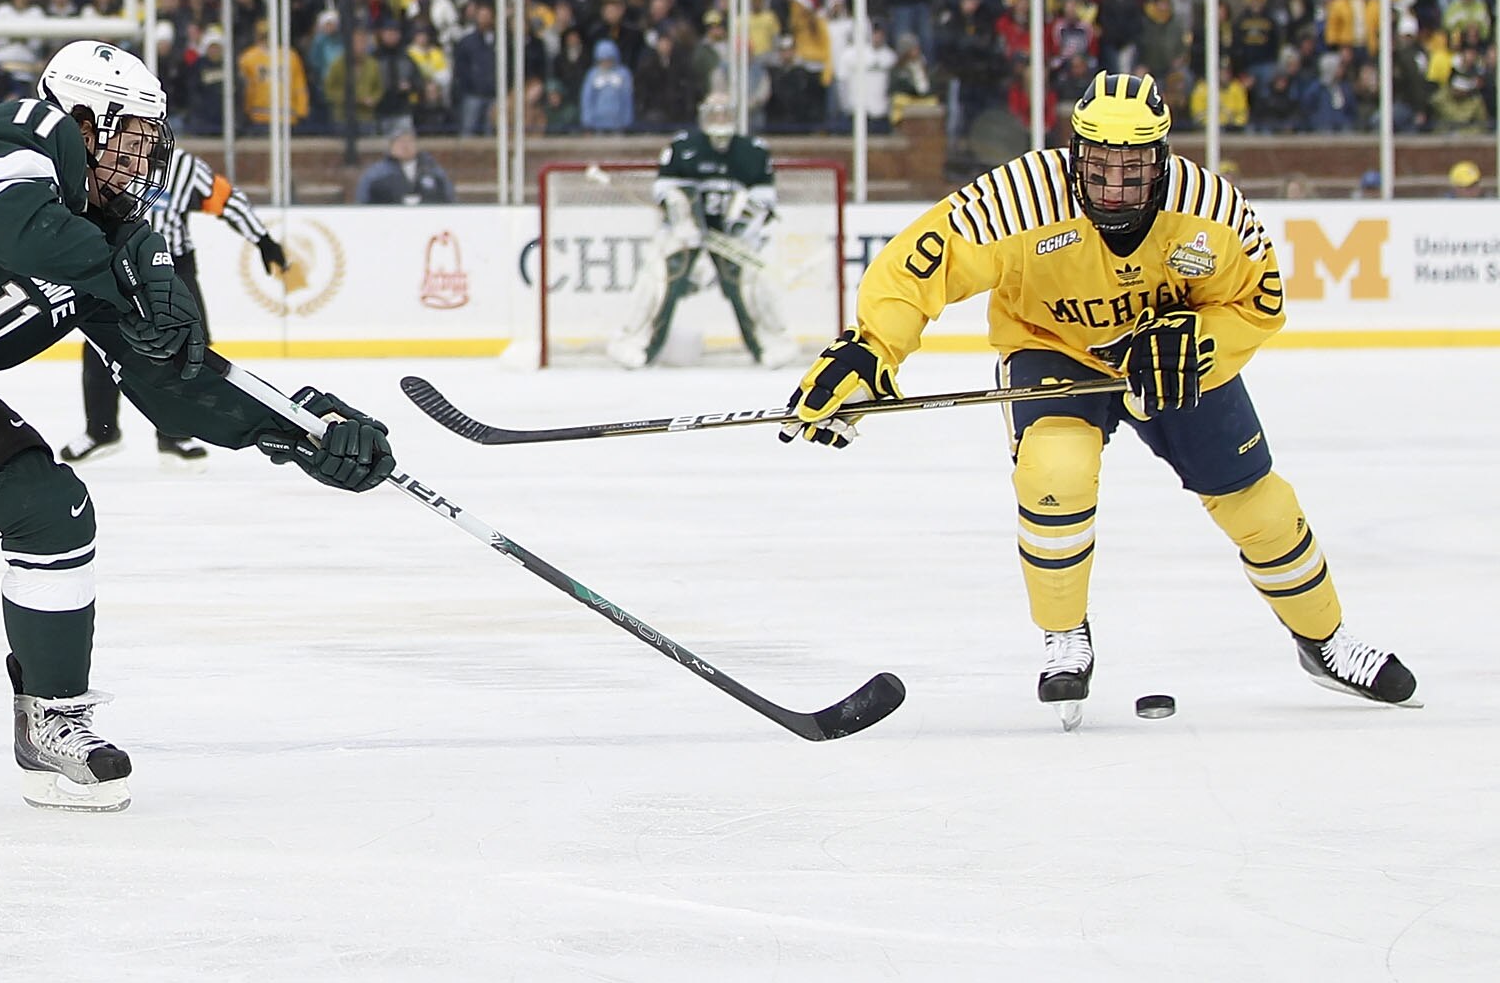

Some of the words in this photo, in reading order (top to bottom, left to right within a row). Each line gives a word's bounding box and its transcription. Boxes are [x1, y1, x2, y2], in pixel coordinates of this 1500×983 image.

[12, 98, 68, 139] 11
[906, 232, 945, 279] 9
[1285, 219, 1389, 300] M
[666, 407, 791, 428] BAUE
[587, 589, 681, 662] VAPOR
